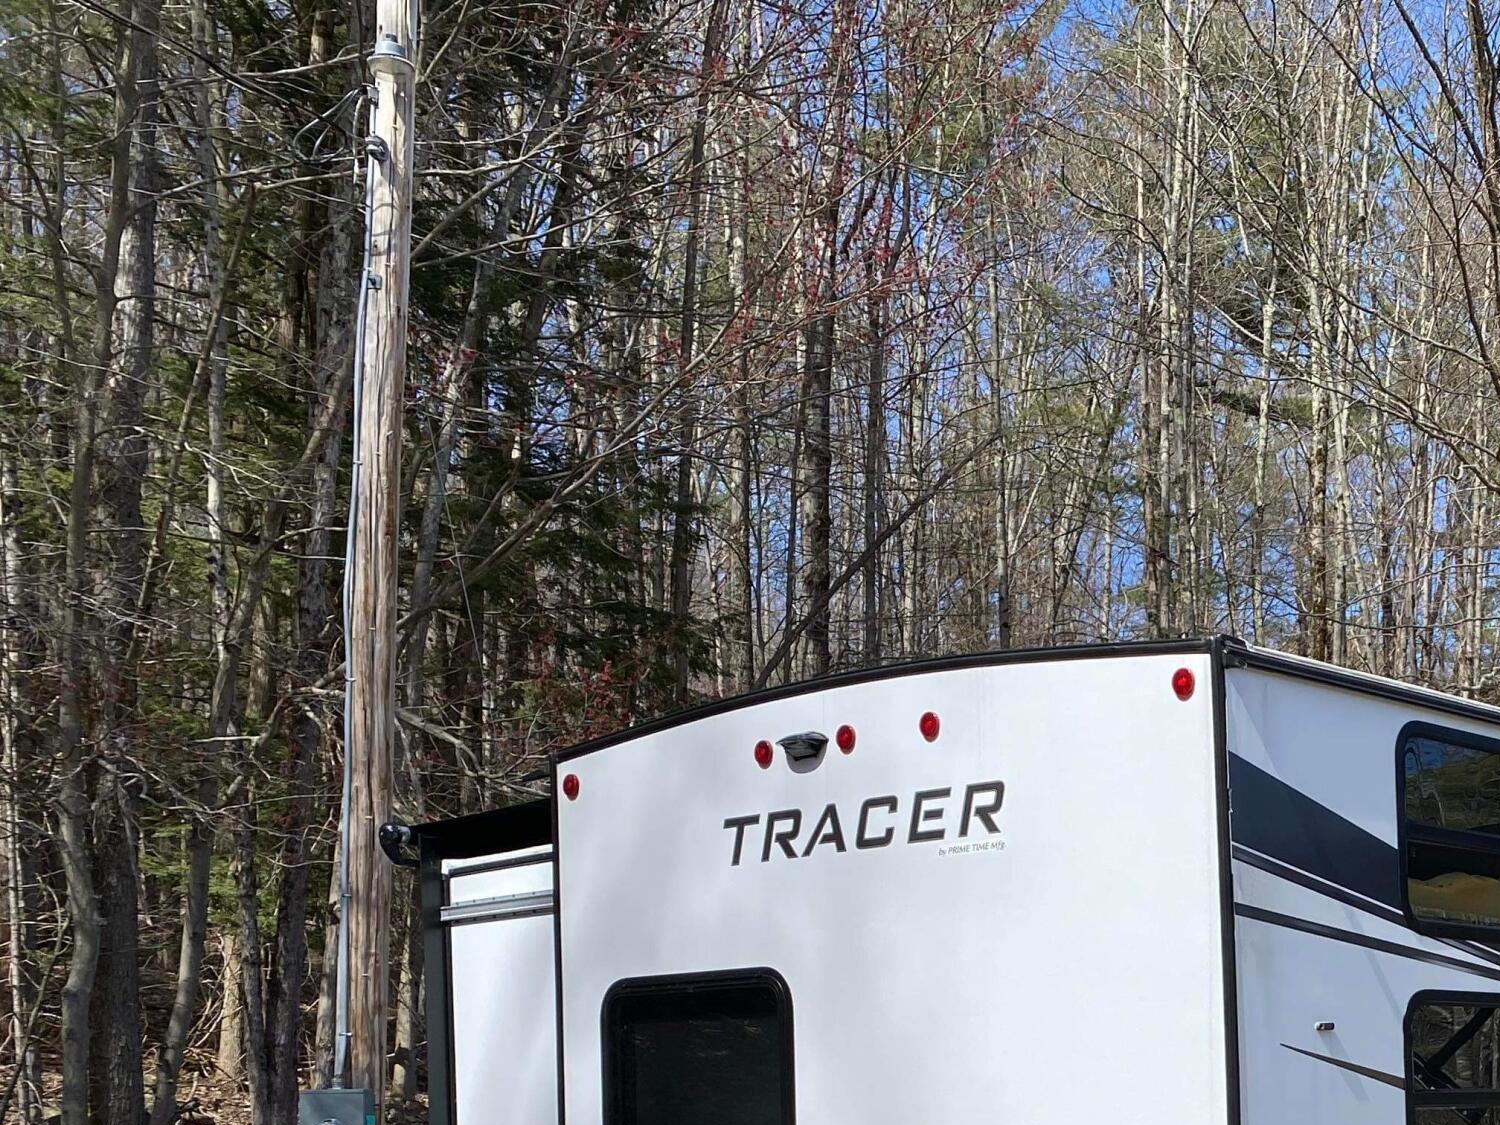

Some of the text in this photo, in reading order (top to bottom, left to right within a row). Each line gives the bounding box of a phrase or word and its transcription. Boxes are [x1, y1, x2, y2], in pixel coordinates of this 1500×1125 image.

[723, 780, 1005, 867] TRACER
[938, 847, 947, 857] by
[948, 844, 971, 854] PRIME
[972, 842, 990, 852] TIME
